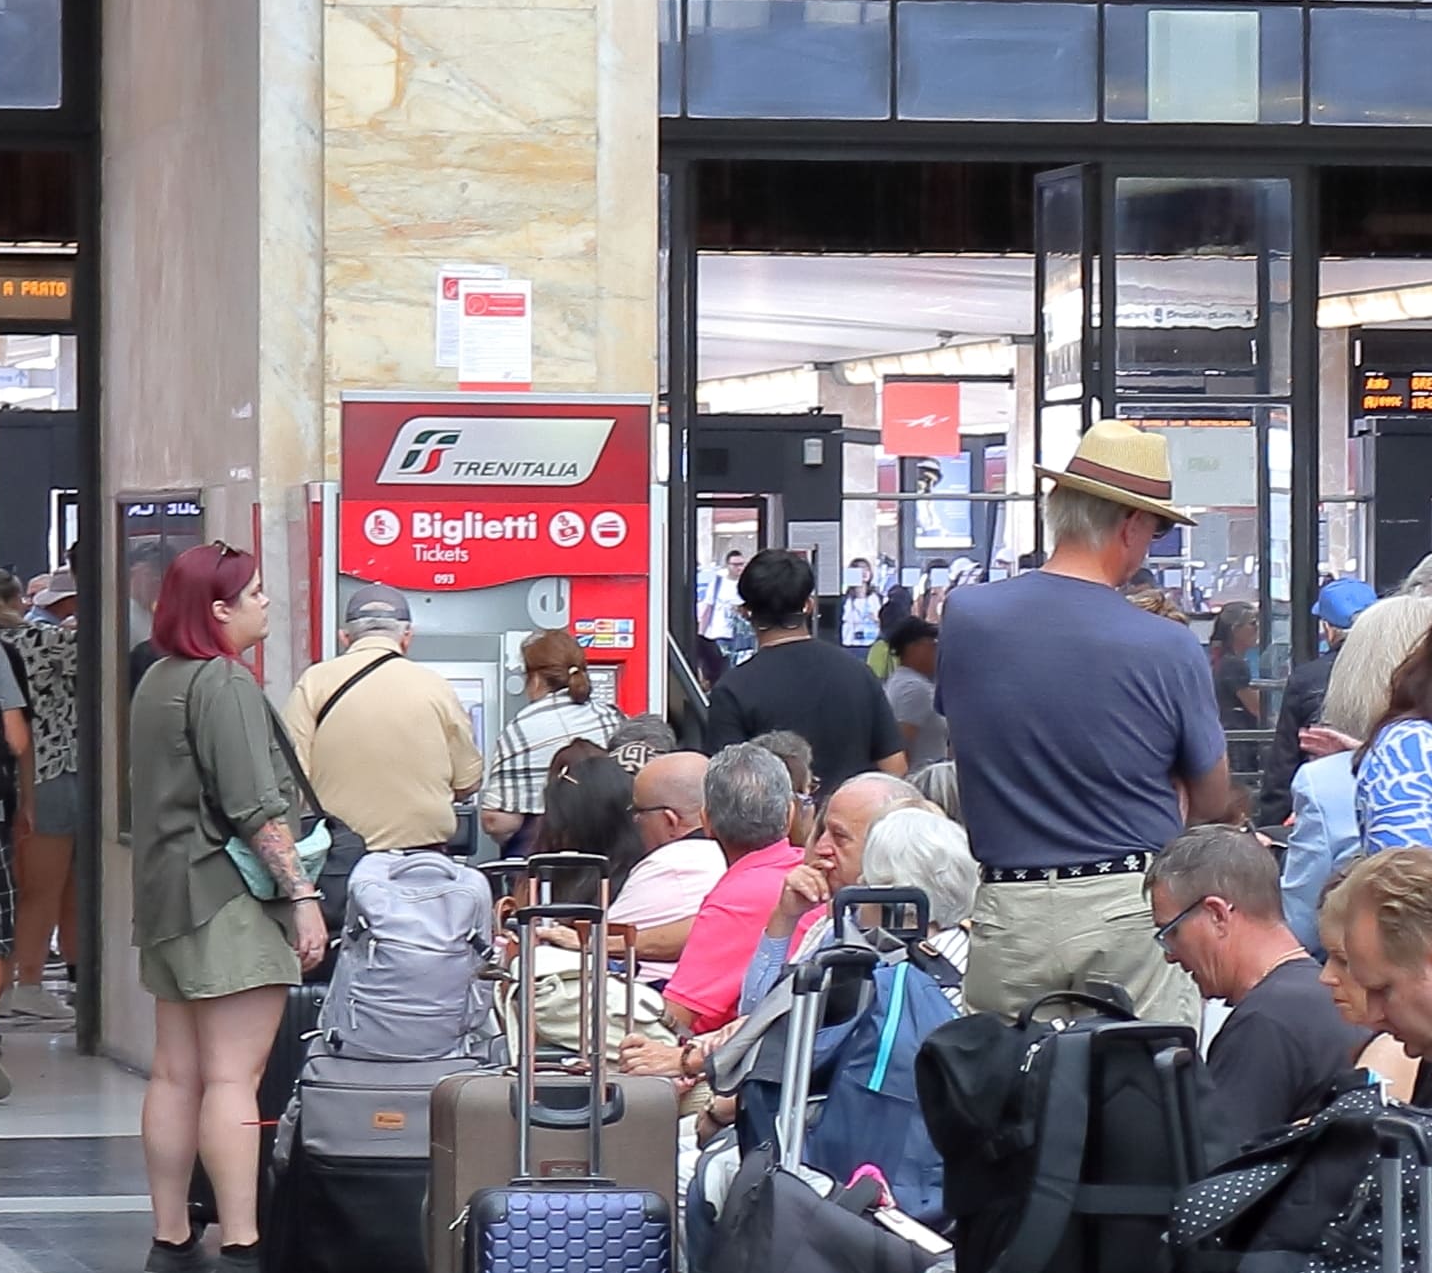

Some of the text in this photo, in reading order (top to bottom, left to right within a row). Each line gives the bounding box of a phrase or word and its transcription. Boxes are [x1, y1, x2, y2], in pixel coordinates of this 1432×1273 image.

[452, 461, 578, 478] TRENITALIA
[411, 512, 538, 545] Biglietti
[413, 544, 469, 563] Tickets
